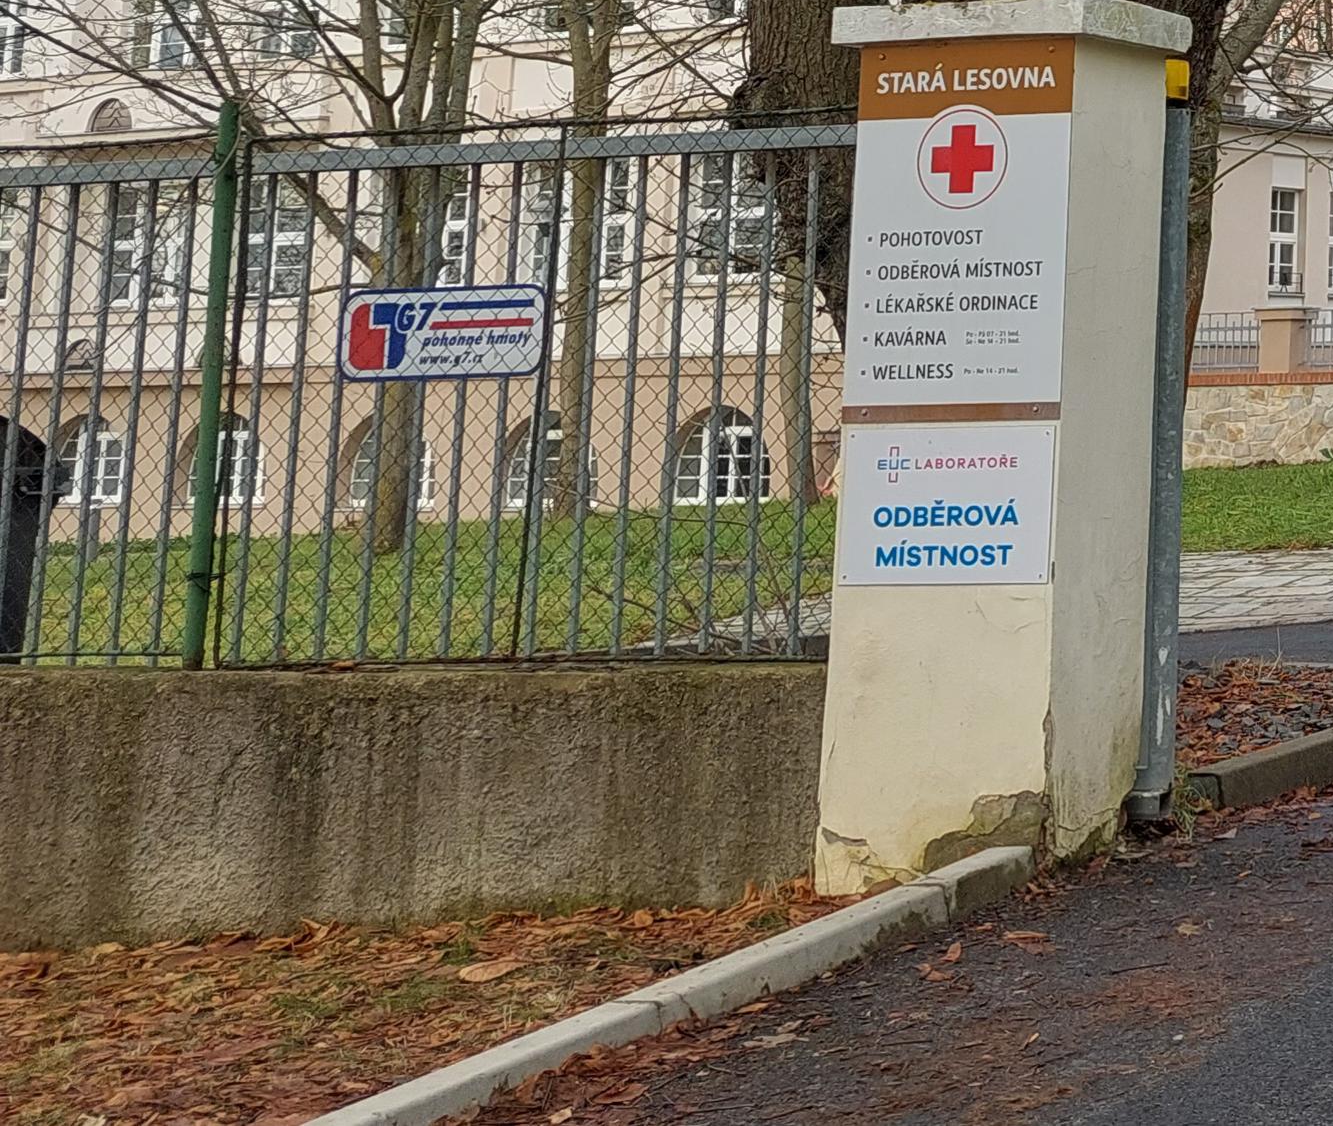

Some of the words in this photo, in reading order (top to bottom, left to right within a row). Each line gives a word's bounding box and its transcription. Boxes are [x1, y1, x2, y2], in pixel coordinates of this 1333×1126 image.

[876, 62, 947, 95] STARÁ
[953, 66, 1056, 91] LESOVNA
[880, 229, 983, 247] POHOTOVOST
[878, 258, 960, 280] ODBĚROVÁ
[965, 257, 1043, 278] MÍSTNOST
[876, 292, 954, 314] LÉKAŘSKÉ
[959, 294, 1039, 311] ORDINACE
[397, 302, 438, 331] G7
[421, 329, 484, 351] pohonné
[486, 330, 531, 348] hmoty
[874, 327, 947, 347] KAVÁRNA
[872, 363, 954, 380] WELLNESS
[877, 458, 911, 470] EUC
[915, 454, 1019, 470] LABORATOŘE
[873, 498, 1019, 528] ODBĚROVÁ
[875, 539, 1014, 567] MÍSTNOST
